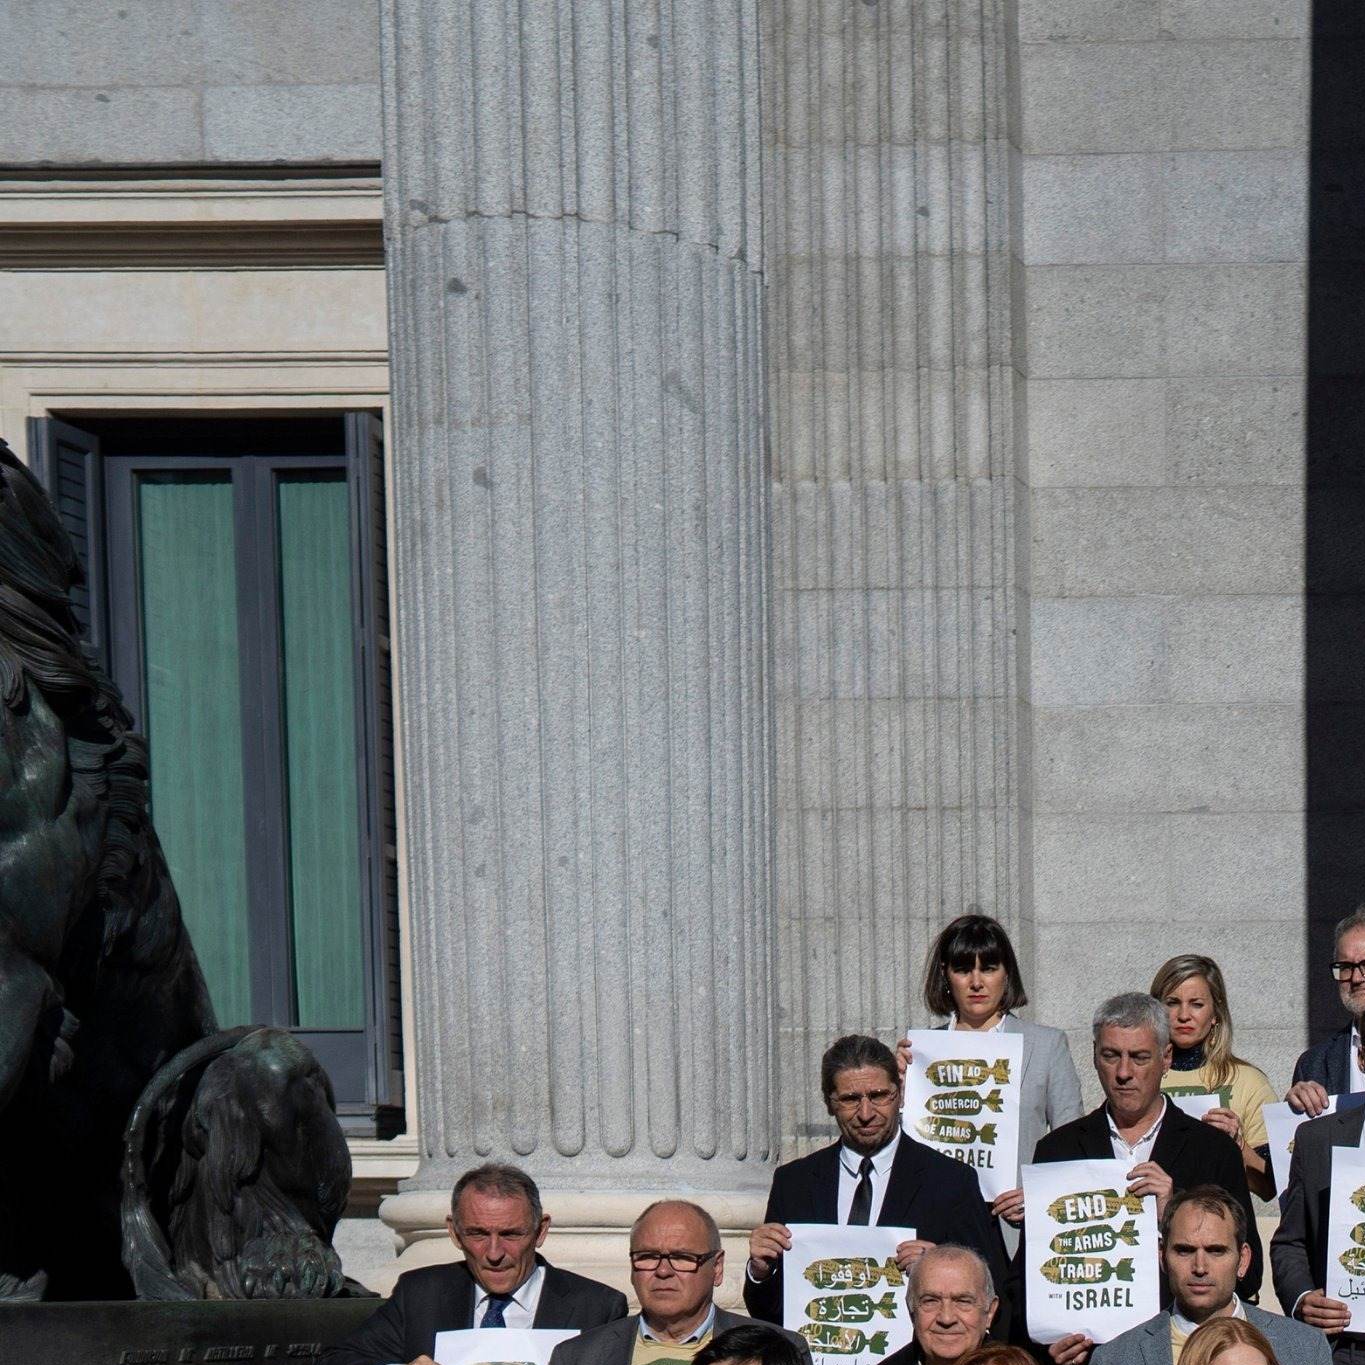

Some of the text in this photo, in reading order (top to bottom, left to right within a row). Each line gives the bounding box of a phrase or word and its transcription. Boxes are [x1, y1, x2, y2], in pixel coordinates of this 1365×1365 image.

[938, 1066, 980, 1083] FIN AO
[932, 1099, 980, 1110] COMERCIO
[940, 1125, 970, 1139] ARMAS
[1065, 1195, 1106, 1218] END
[1059, 1231, 1113, 1251] THE ARMS
[1059, 1263, 1103, 1279] TRADE
[1066, 1288, 1133, 1310] ISRAEL
